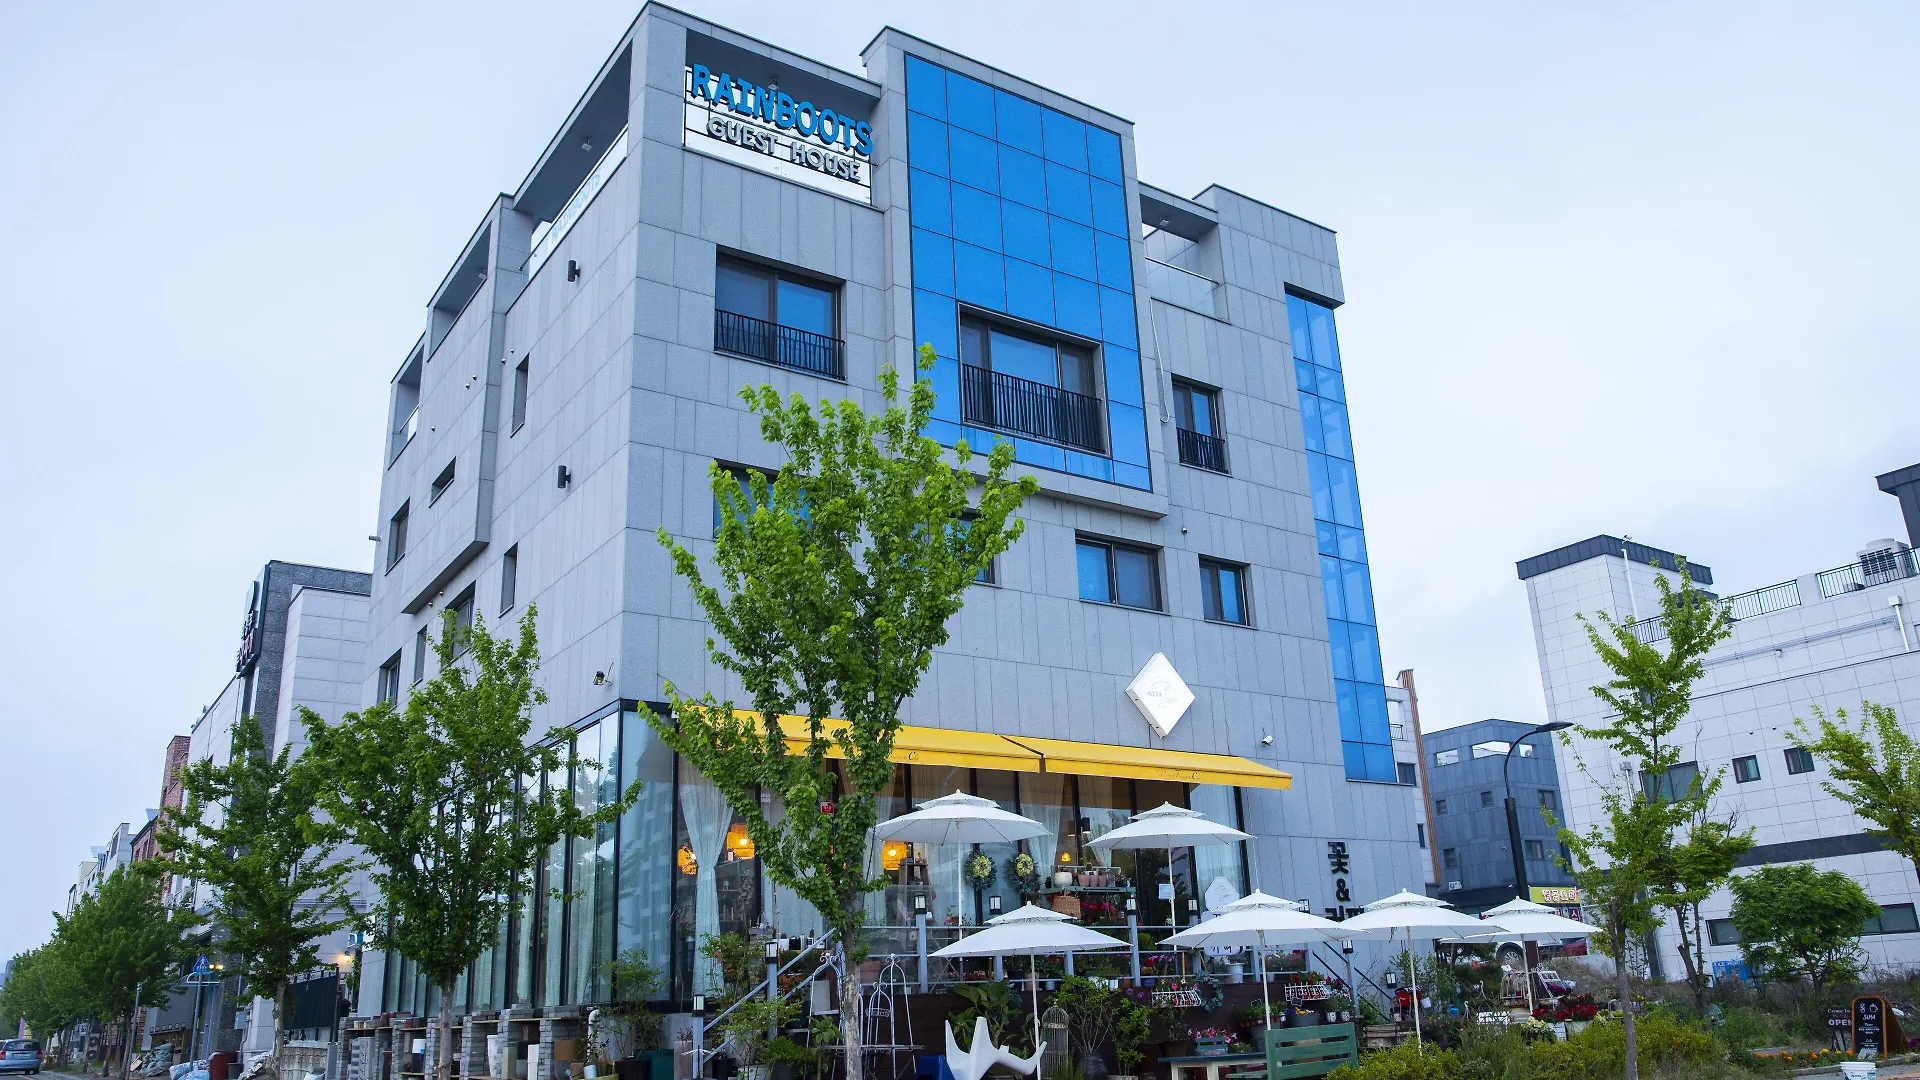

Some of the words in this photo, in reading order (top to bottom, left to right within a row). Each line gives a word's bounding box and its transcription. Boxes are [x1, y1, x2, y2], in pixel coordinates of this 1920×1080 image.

[691, 63, 873, 156] RAINBOOTS
[706, 116, 778, 155] GUEST
[790, 141, 862, 182] HOUSE
[1327, 841, 1350, 875] 꽃
[1336, 878, 1351, 902] &
